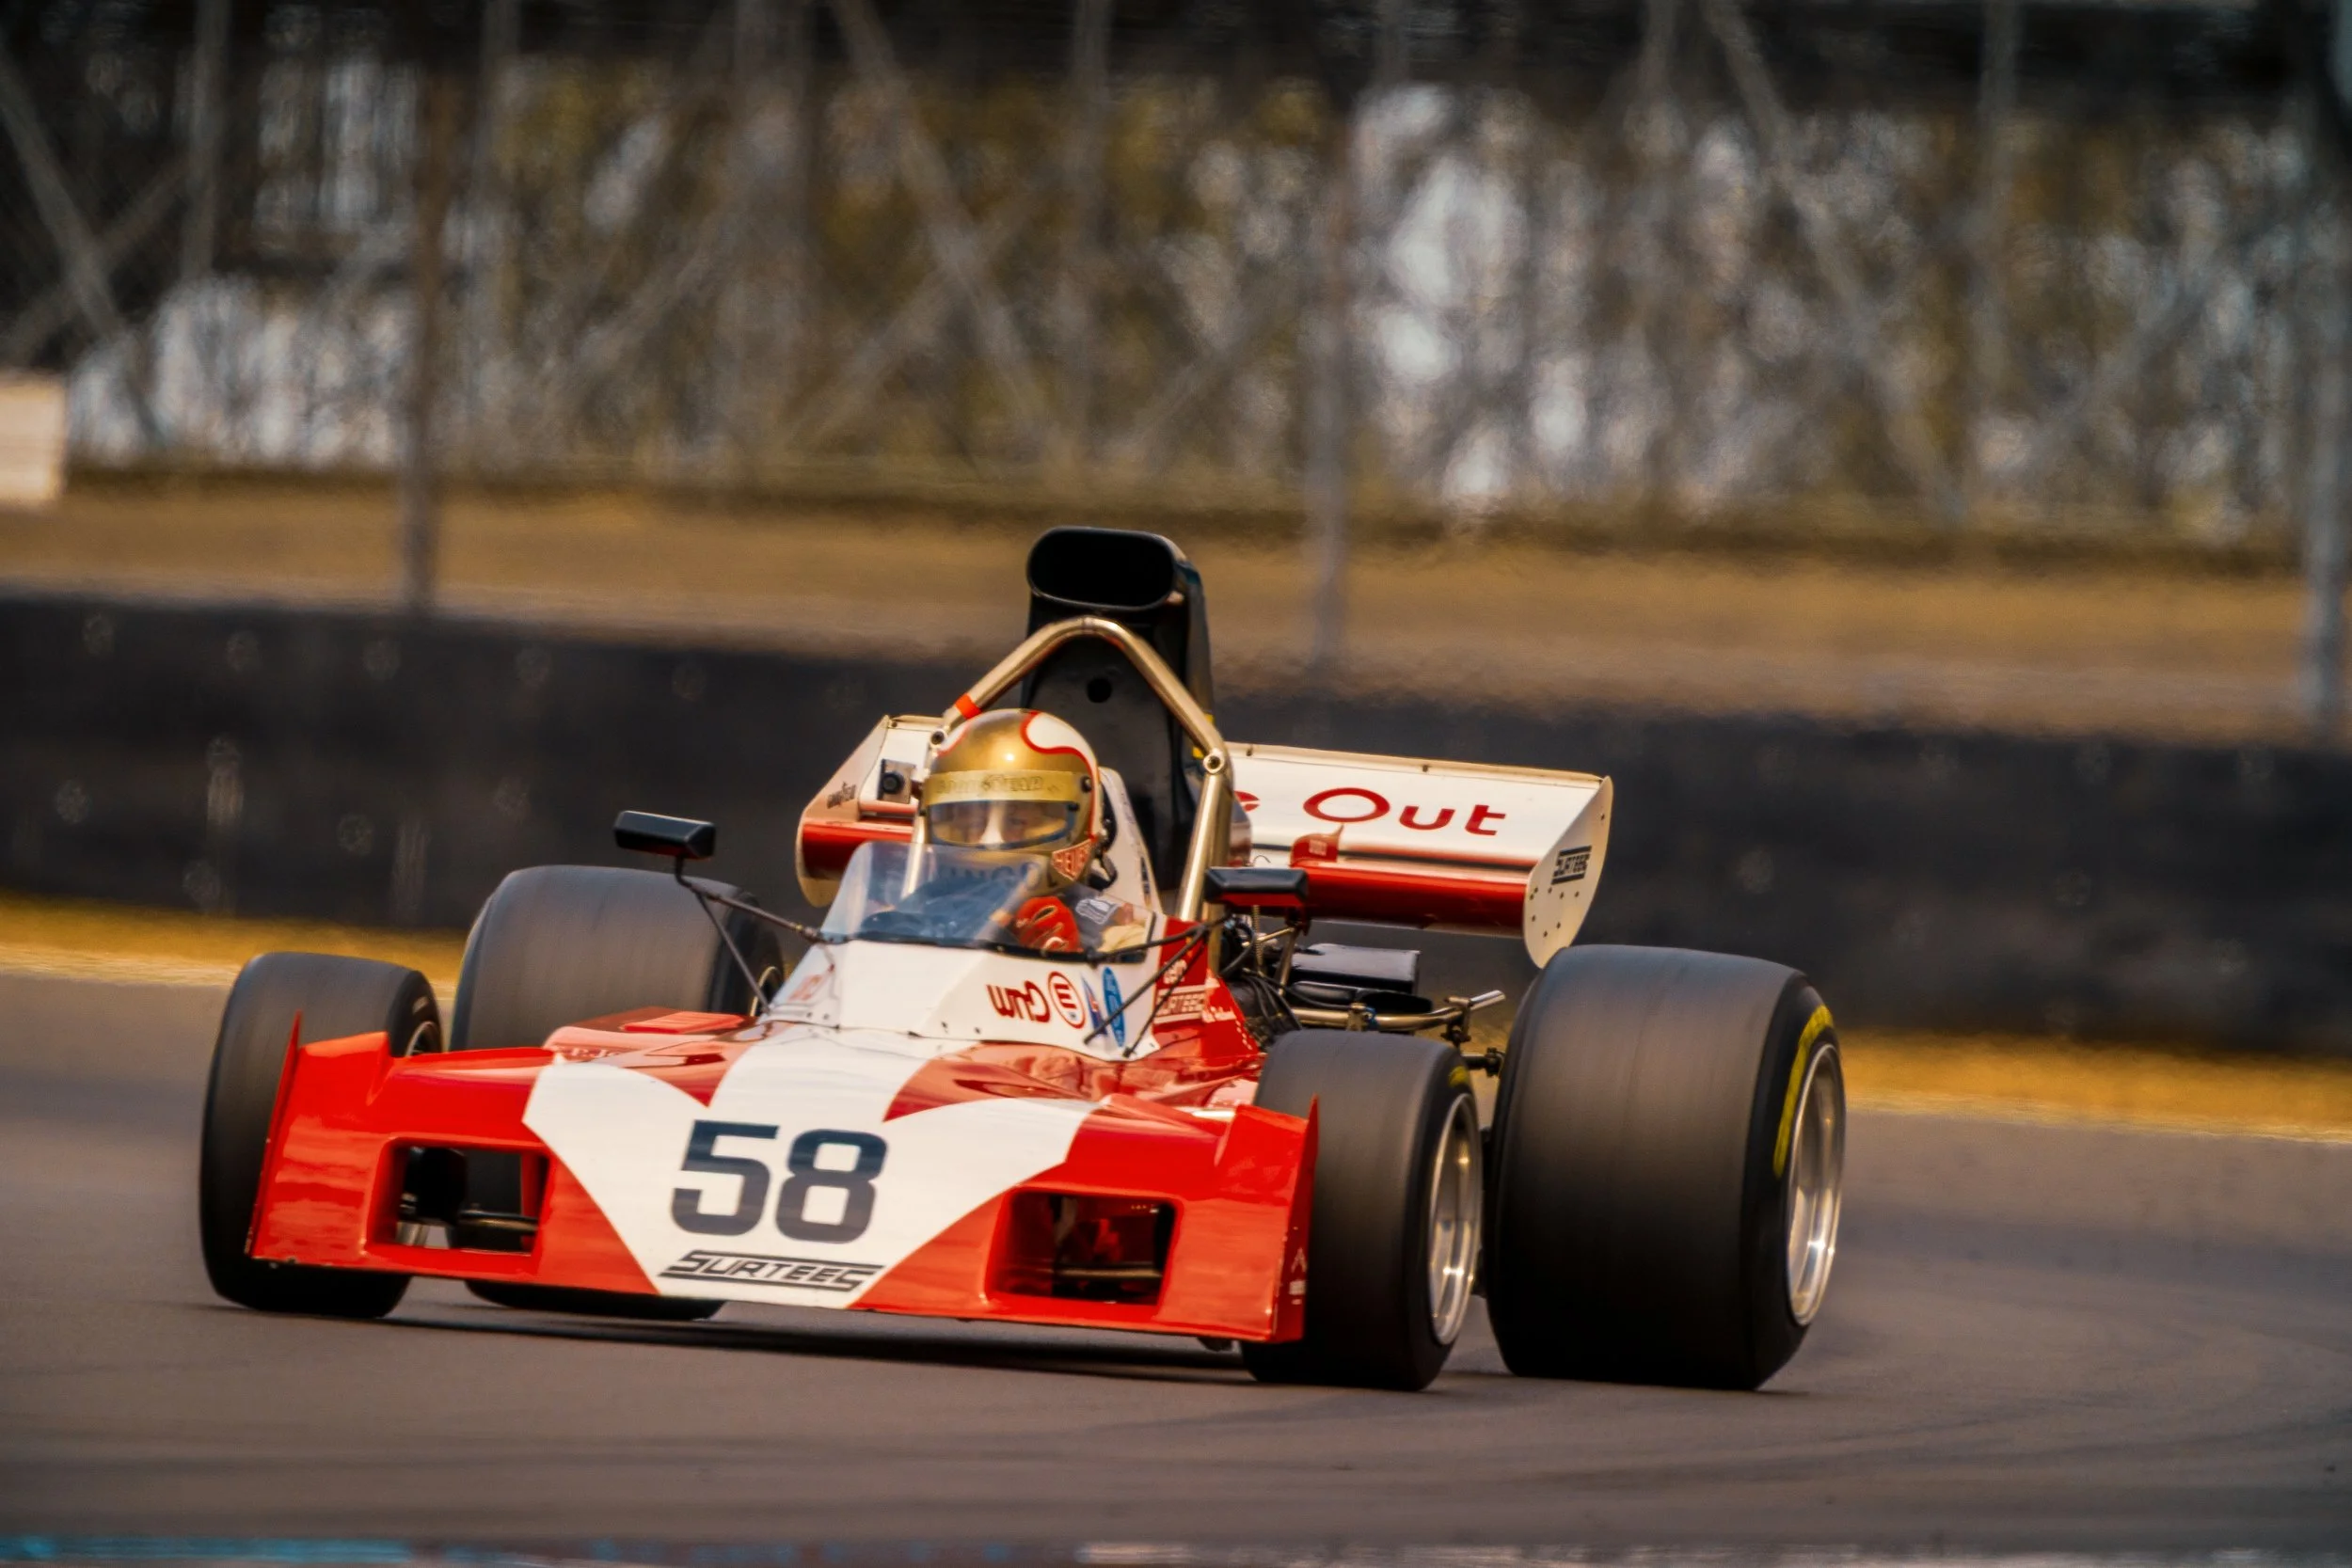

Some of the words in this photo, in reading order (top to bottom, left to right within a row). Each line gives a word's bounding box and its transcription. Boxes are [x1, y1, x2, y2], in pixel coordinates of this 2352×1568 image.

[1302, 786, 1506, 836] Out
[670, 1119, 889, 1243] 58
[660, 1249, 884, 1292] SURTEES
